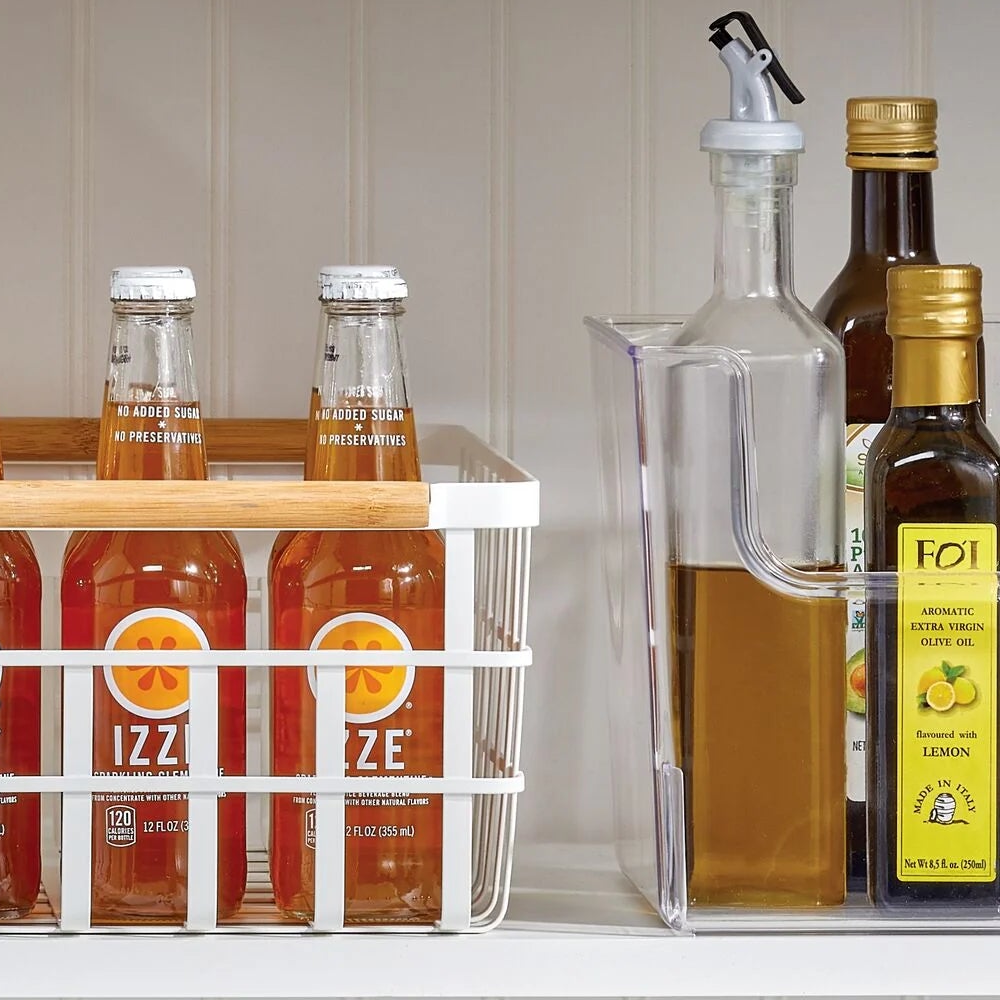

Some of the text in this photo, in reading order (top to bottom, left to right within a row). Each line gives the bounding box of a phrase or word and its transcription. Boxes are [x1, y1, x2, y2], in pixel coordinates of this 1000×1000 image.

[117, 405, 130, 417] NO
[133, 406, 170, 418] ADDED
[332, 408, 367, 420] ADDED
[371, 409, 405, 421] SUGAR
[114, 431, 202, 444] NO PRESERVATIVES
[329, 434, 407, 446] PRESERVATIVES
[921, 607, 975, 616] AROMATIC
[910, 622, 985, 632] EXTRA VIRGIN
[920, 638, 975, 647] OLIVE OIL
[916, 730, 978, 740] flavoured with
[114, 724, 189, 766] IZZ
[345, 729, 405, 770] ZE
[923, 746, 970, 758] LEMON
[105, 794, 145, 802] CONCENTRATE
[146, 794, 162, 802] WITH
[162, 793, 182, 801] OTHER
[360, 798, 381, 806] OTHER
[381, 798, 407, 806] NATURAL
[407, 797, 429, 805] FLAVORS
[913, 780, 977, 815] MADE IN ITALY
[109, 810, 132, 826] 120
[108, 827, 134, 835] CALORIES
[143, 820, 179, 832] 12 FL OZ
[353, 825, 415, 837] FL OZ (355 mL)
[904, 858, 987, 870] Net Wt 8,5 fl. oz. (250ml)
